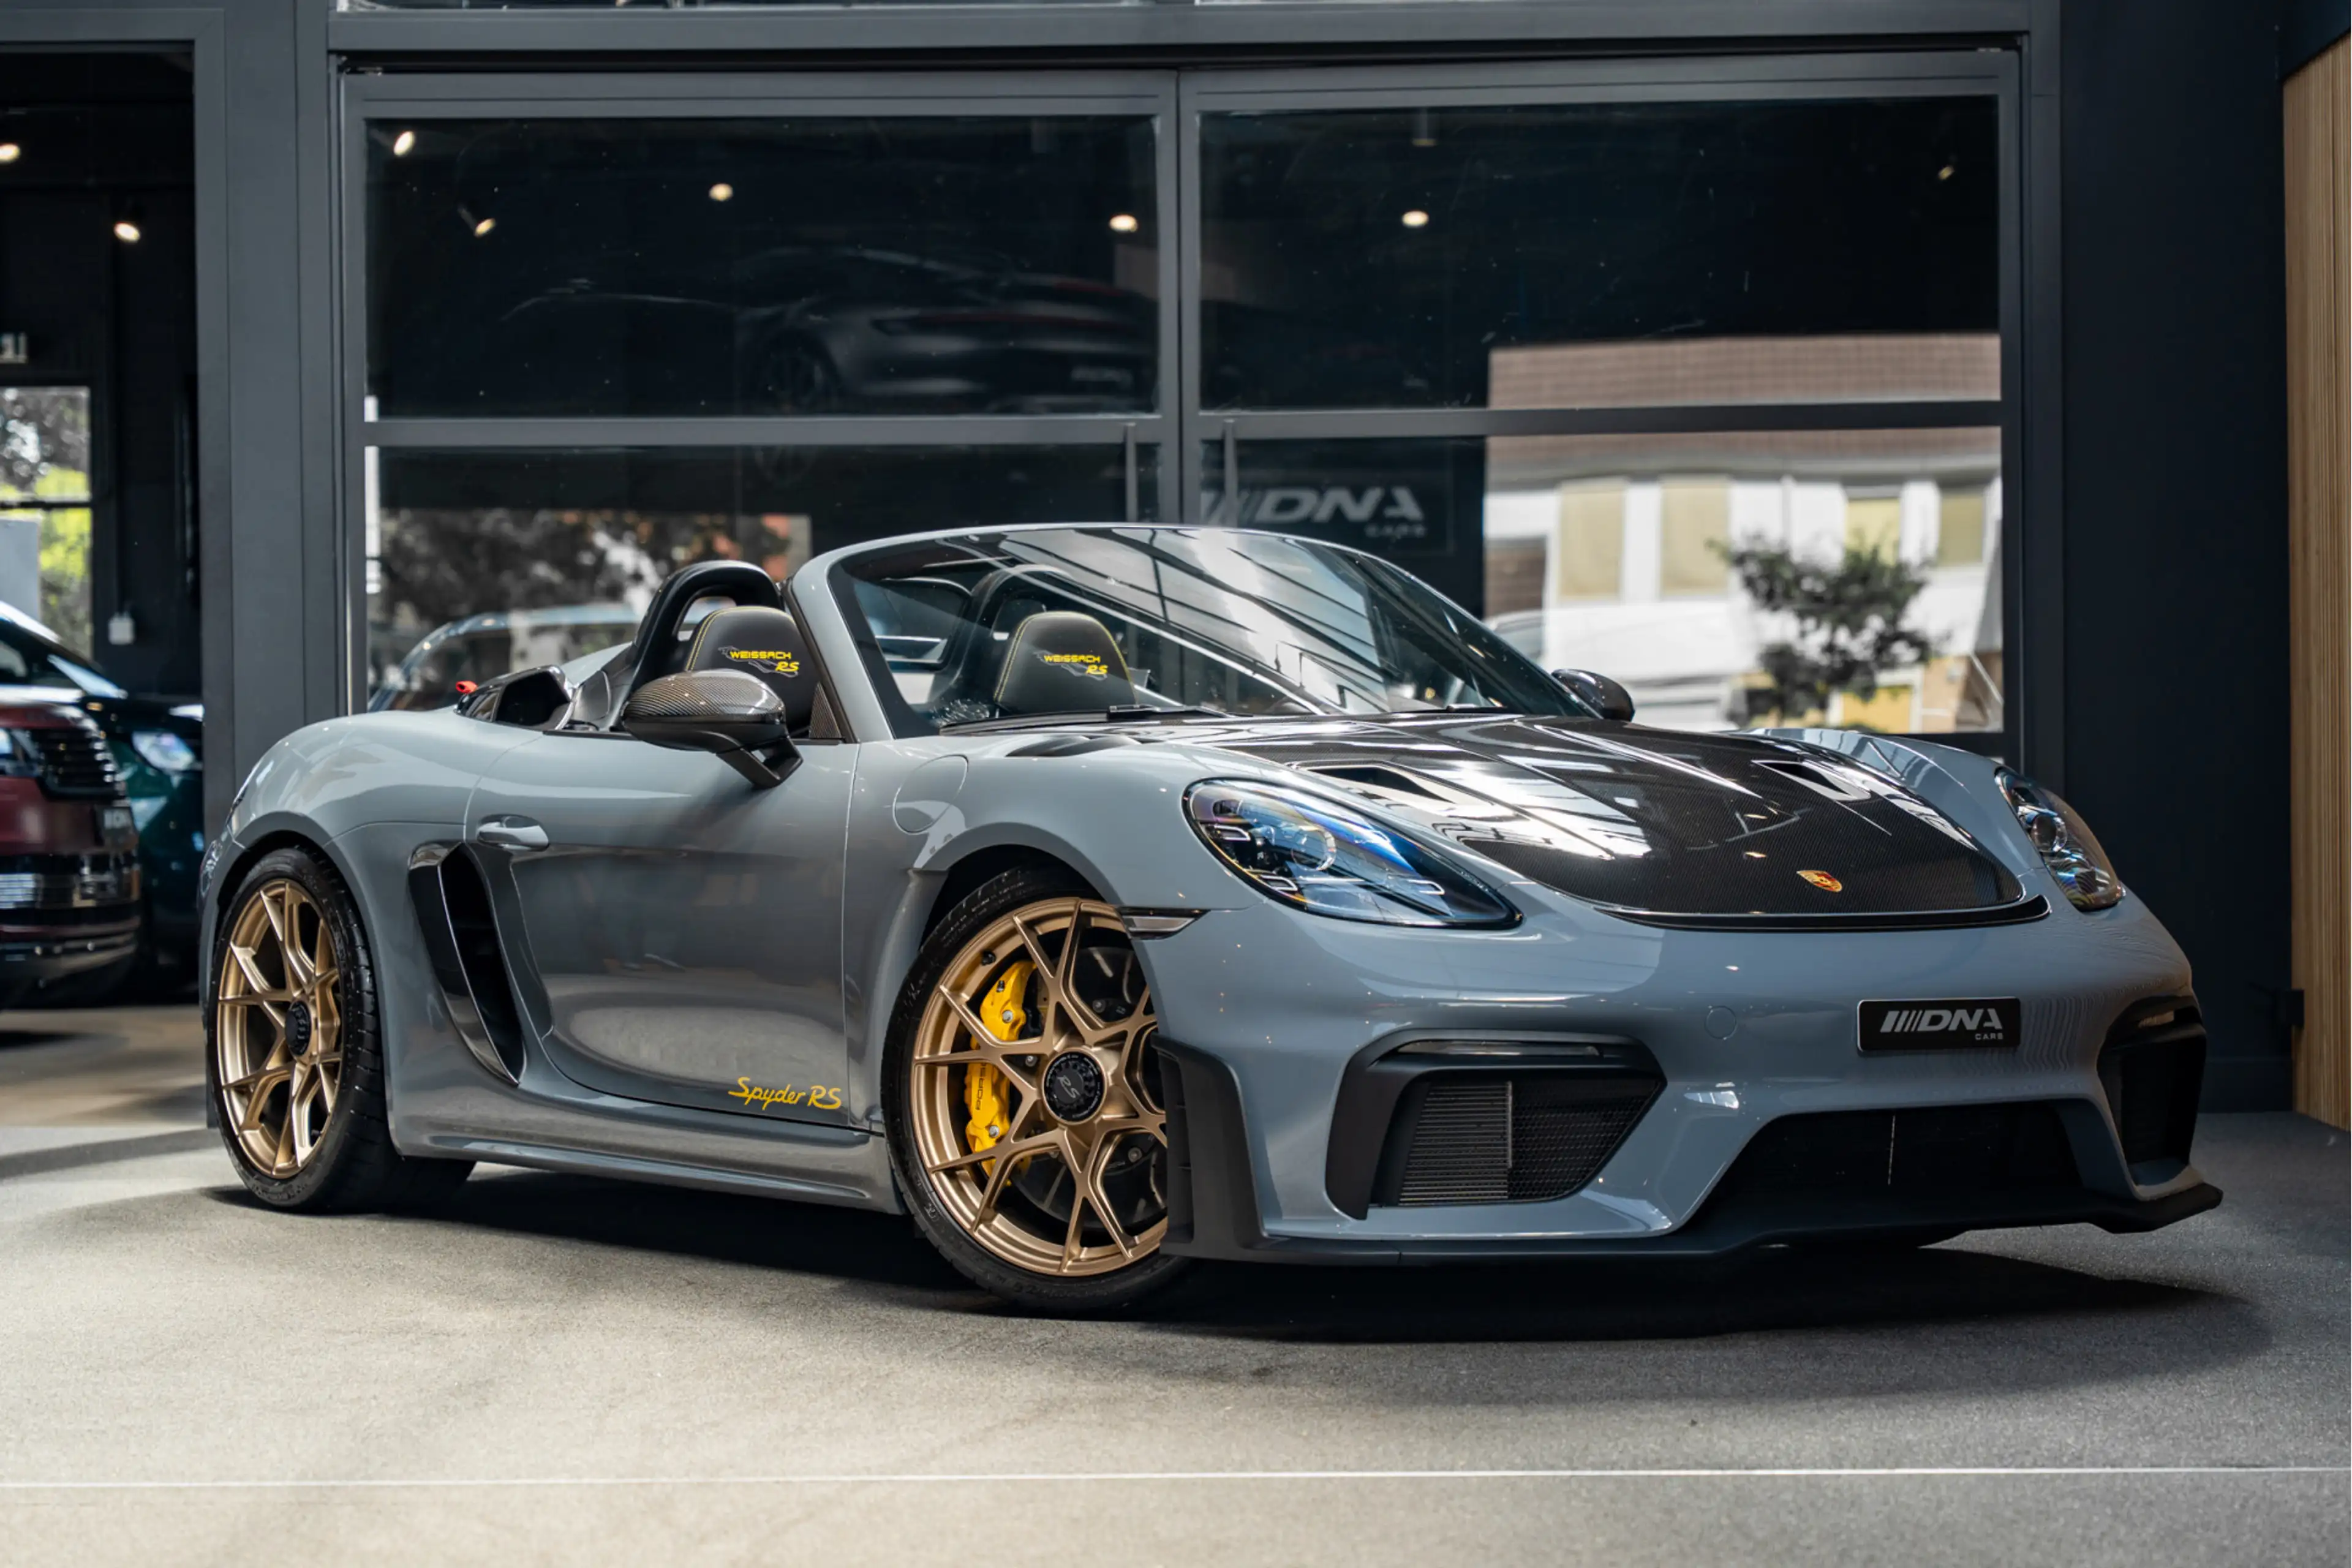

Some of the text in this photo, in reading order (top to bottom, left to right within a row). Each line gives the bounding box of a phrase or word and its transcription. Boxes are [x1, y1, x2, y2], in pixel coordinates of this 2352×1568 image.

[729, 650, 792, 660] WEISSACH
[775, 661, 800, 673] RS
[1085, 664, 1109, 675] RS
[1974, 1032, 2004, 1041] CARS
[727, 1076, 842, 1111] Spyder RS
